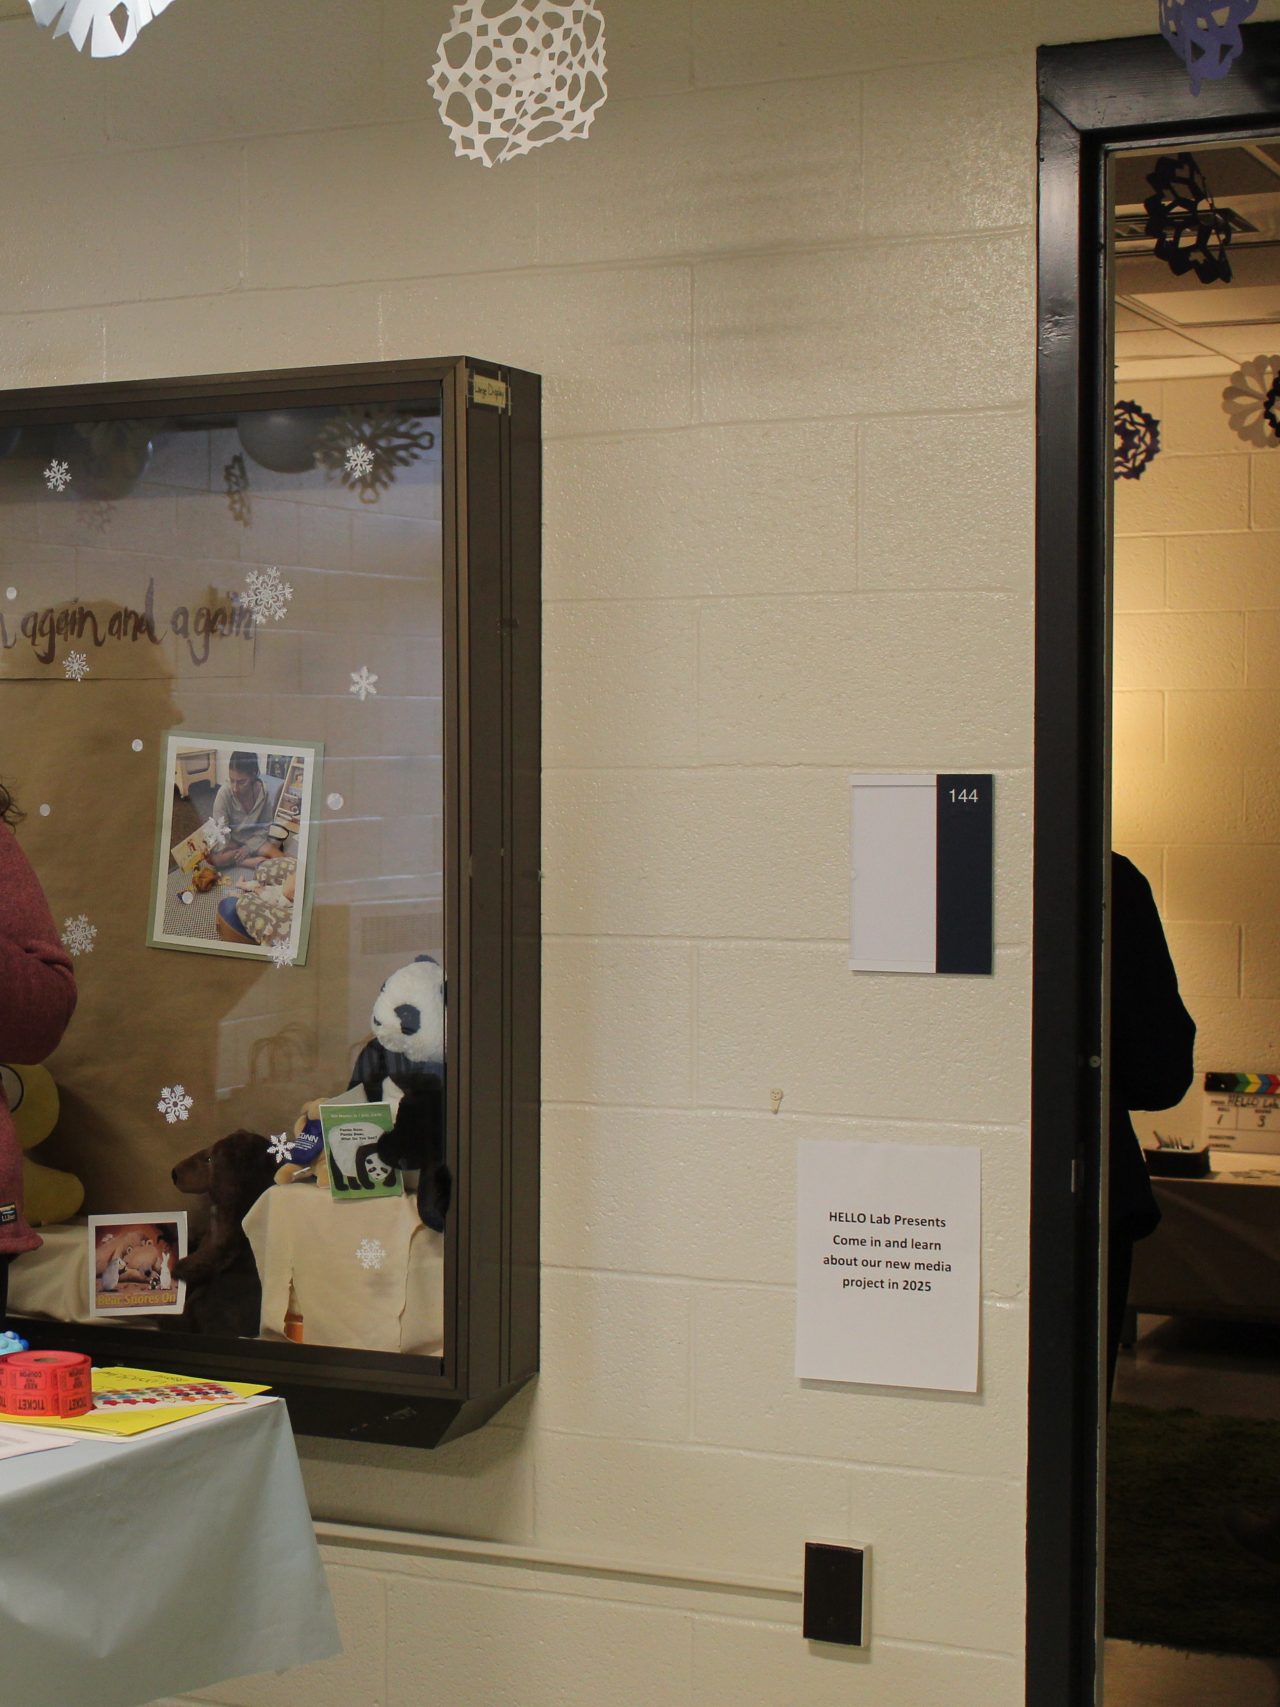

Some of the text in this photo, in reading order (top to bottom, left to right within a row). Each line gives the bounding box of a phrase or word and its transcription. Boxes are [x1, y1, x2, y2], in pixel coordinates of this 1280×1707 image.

[20, 597, 108, 665] again
[108, 577, 168, 645] and
[171, 591, 256, 667] again
[948, 788, 979, 803] 144
[829, 1211, 946, 1228] HELLO Lab Presents
[833, 1235, 942, 1251] Come in and learn
[823, 1254, 952, 1272] about our new media
[842, 1277, 932, 1291] project in 2025
[124, 1293, 160, 1305] Snores
[161, 1291, 177, 1303] On
[18, 1399, 45, 1411] TICKET
